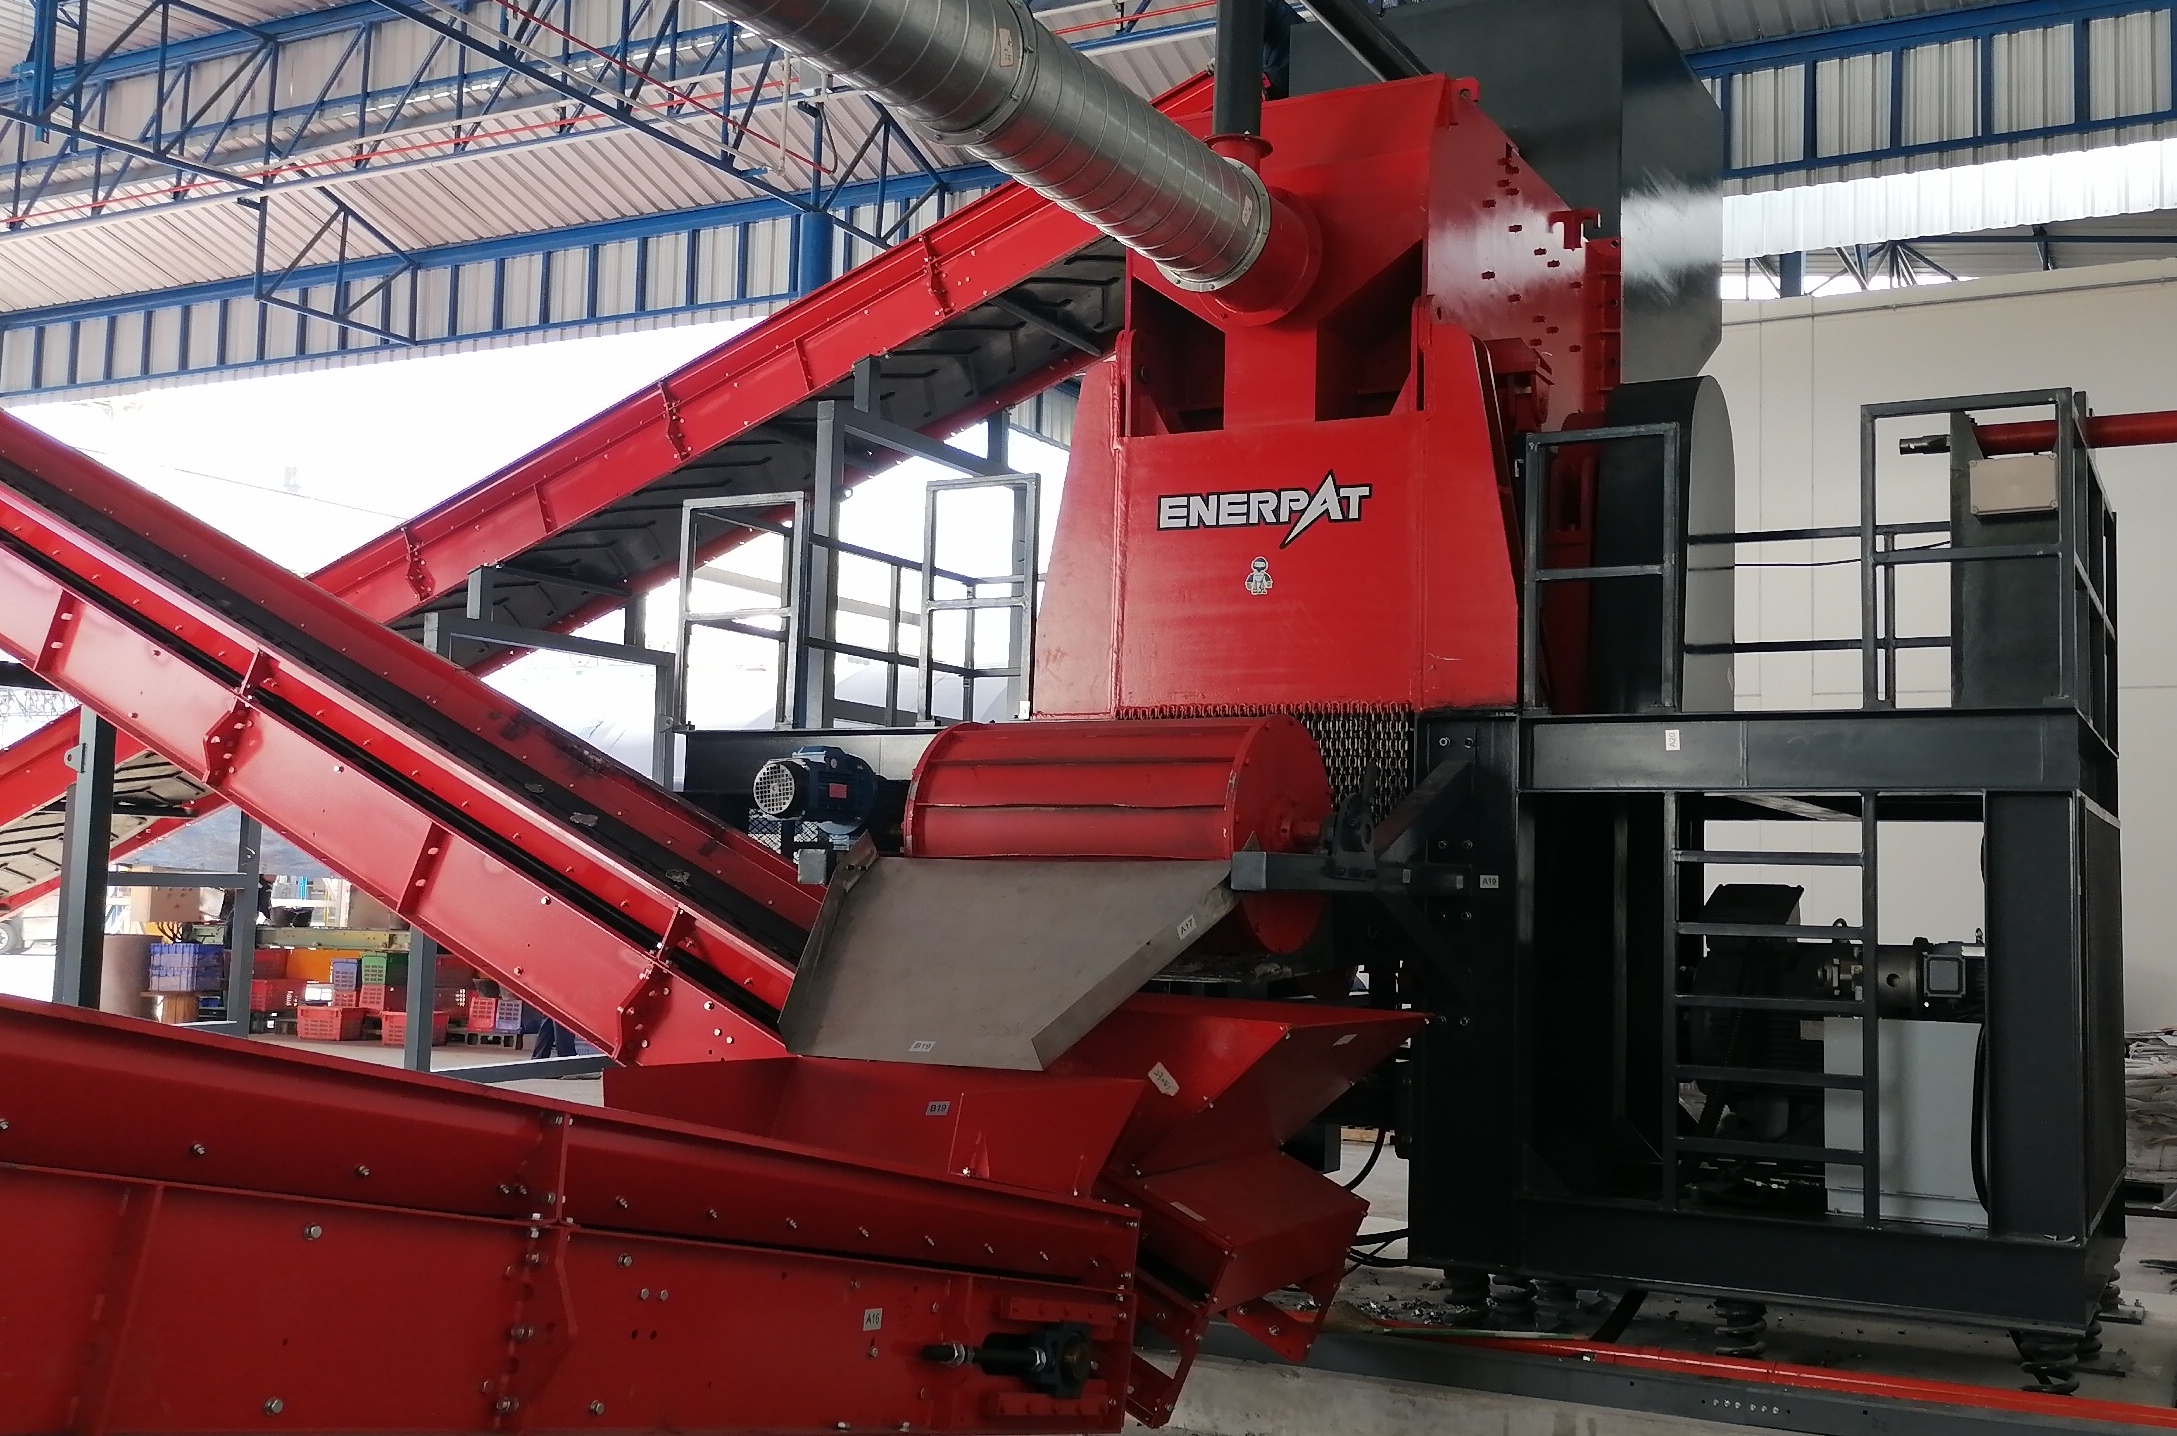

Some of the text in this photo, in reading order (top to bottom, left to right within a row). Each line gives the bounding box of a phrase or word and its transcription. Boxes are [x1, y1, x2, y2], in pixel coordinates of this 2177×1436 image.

[1158, 469, 1373, 548] ENERPAT
[1668, 732, 1677, 748] A20
[1482, 877, 1497, 885] A19
[1180, 918, 1193, 935] A17
[913, 1042, 932, 1050] B19
[929, 1104, 947, 1112] B19
[865, 1312, 880, 1325] A16
